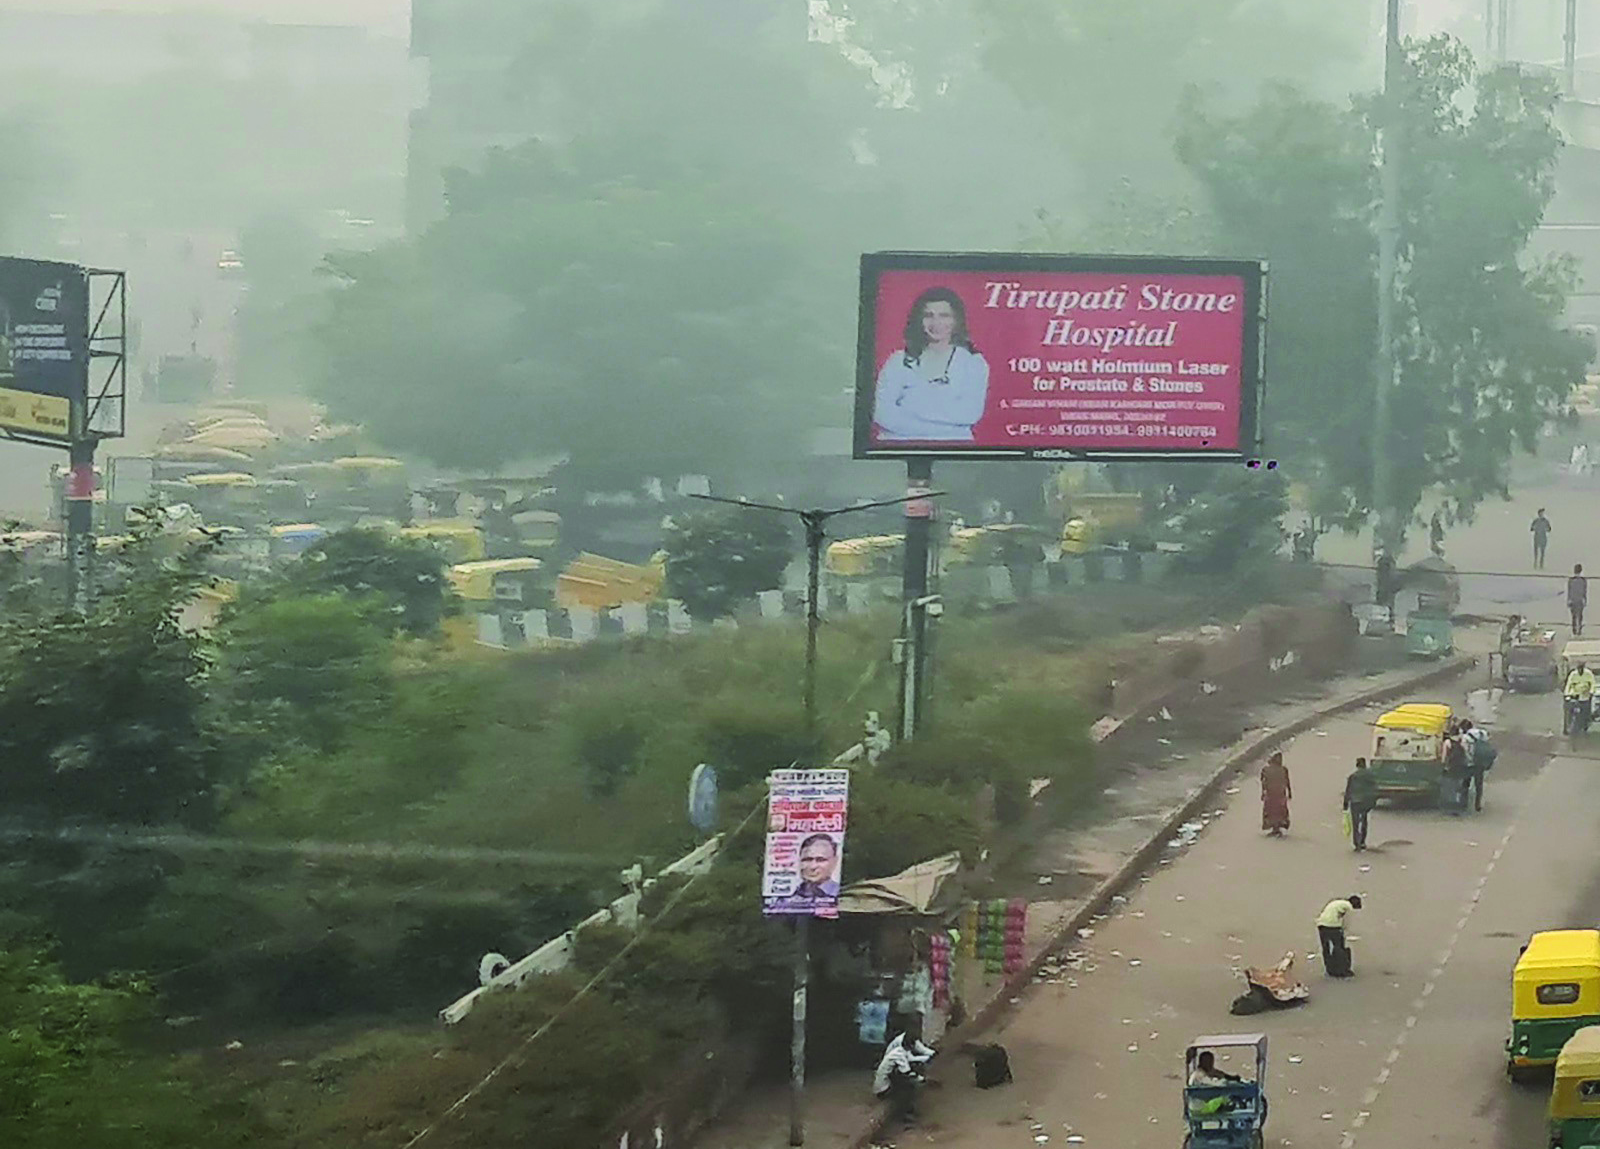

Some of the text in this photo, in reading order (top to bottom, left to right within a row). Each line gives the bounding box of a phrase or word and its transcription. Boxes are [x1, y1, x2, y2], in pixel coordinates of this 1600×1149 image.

[984, 281, 1237, 316] Tirupati Stone
[1041, 319, 1178, 353] Hospital
[1007, 358, 1230, 376] 100 watt Holmium Laser
[1033, 376, 1205, 393] for Prostate & Stones
